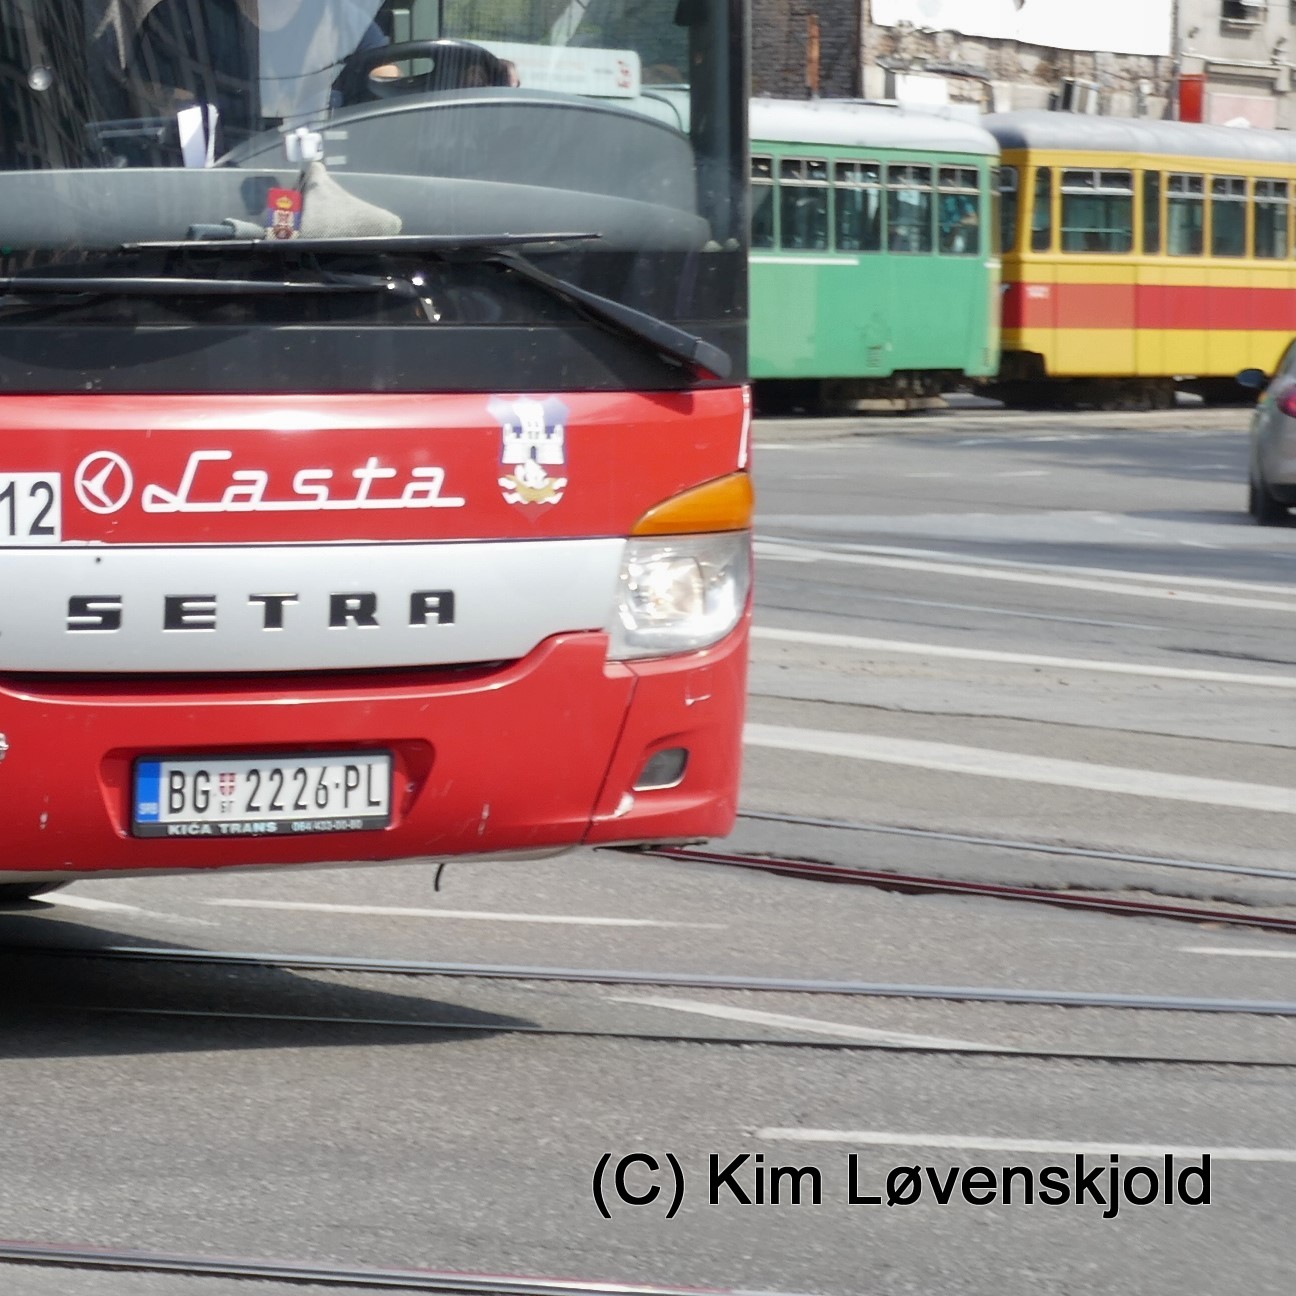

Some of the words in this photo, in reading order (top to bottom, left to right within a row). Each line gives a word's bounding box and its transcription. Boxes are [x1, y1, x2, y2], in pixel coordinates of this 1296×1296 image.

[141, 450, 466, 512] Lasta
[65, 588, 456, 633] SETRA
[168, 769, 212, 815] BG
[218, 821, 278, 835] TRANS
